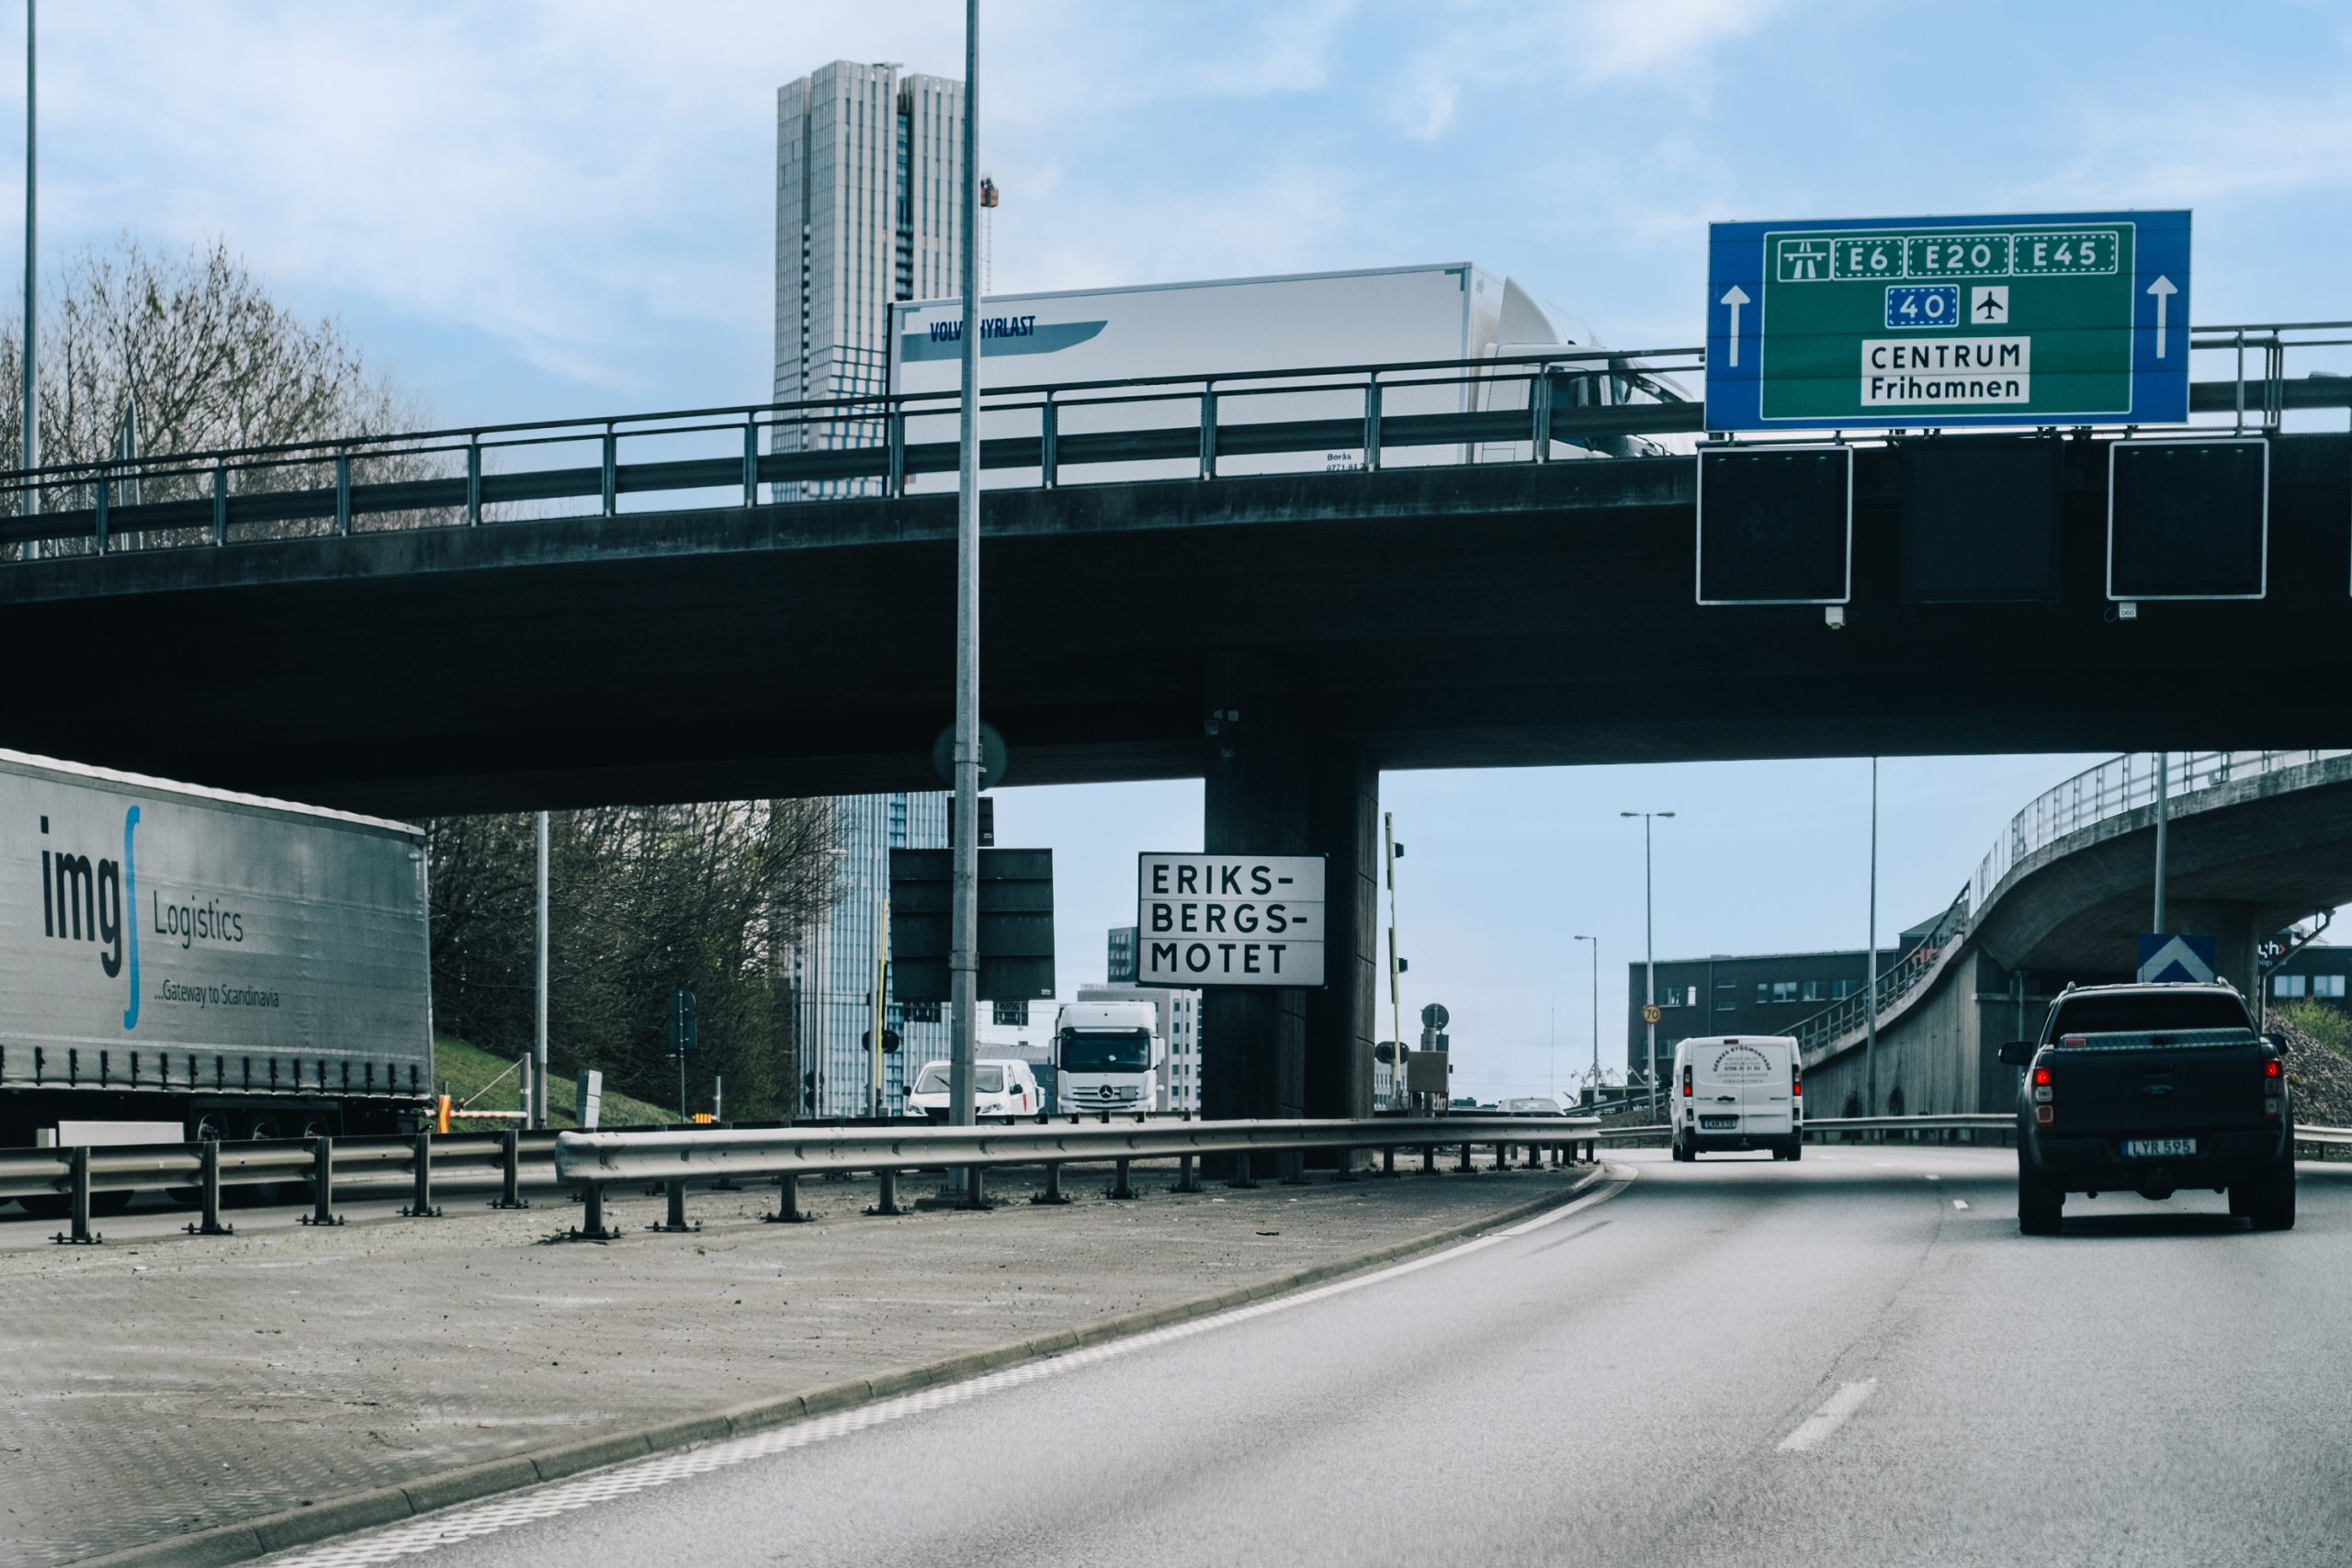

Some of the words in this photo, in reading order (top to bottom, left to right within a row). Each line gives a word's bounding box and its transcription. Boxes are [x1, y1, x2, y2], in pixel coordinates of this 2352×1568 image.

[1849, 247, 1888, 270] E6
[1926, 244, 1991, 269] E20
[2033, 242, 2097, 265] E45
[1899, 295, 1945, 318] 40
[930, 321, 963, 343] VOLV
[1871, 344, 2020, 369] CENTRUM
[1871, 376, 2020, 400] Frihamnen
[1152, 864, 1294, 895] ERIKS-
[153, 889, 243, 950] Logistics
[1152, 903, 1308, 933] BERGS-
[1151, 942, 1287, 974] MOTET
[208, 985, 220, 1004] to
[221, 983, 280, 1008] Scandinavia
[1645, 1009, 1659, 1020] 70
[2132, 1141, 2159, 1155] LYR
[2164, 1140, 2191, 1154] 595
